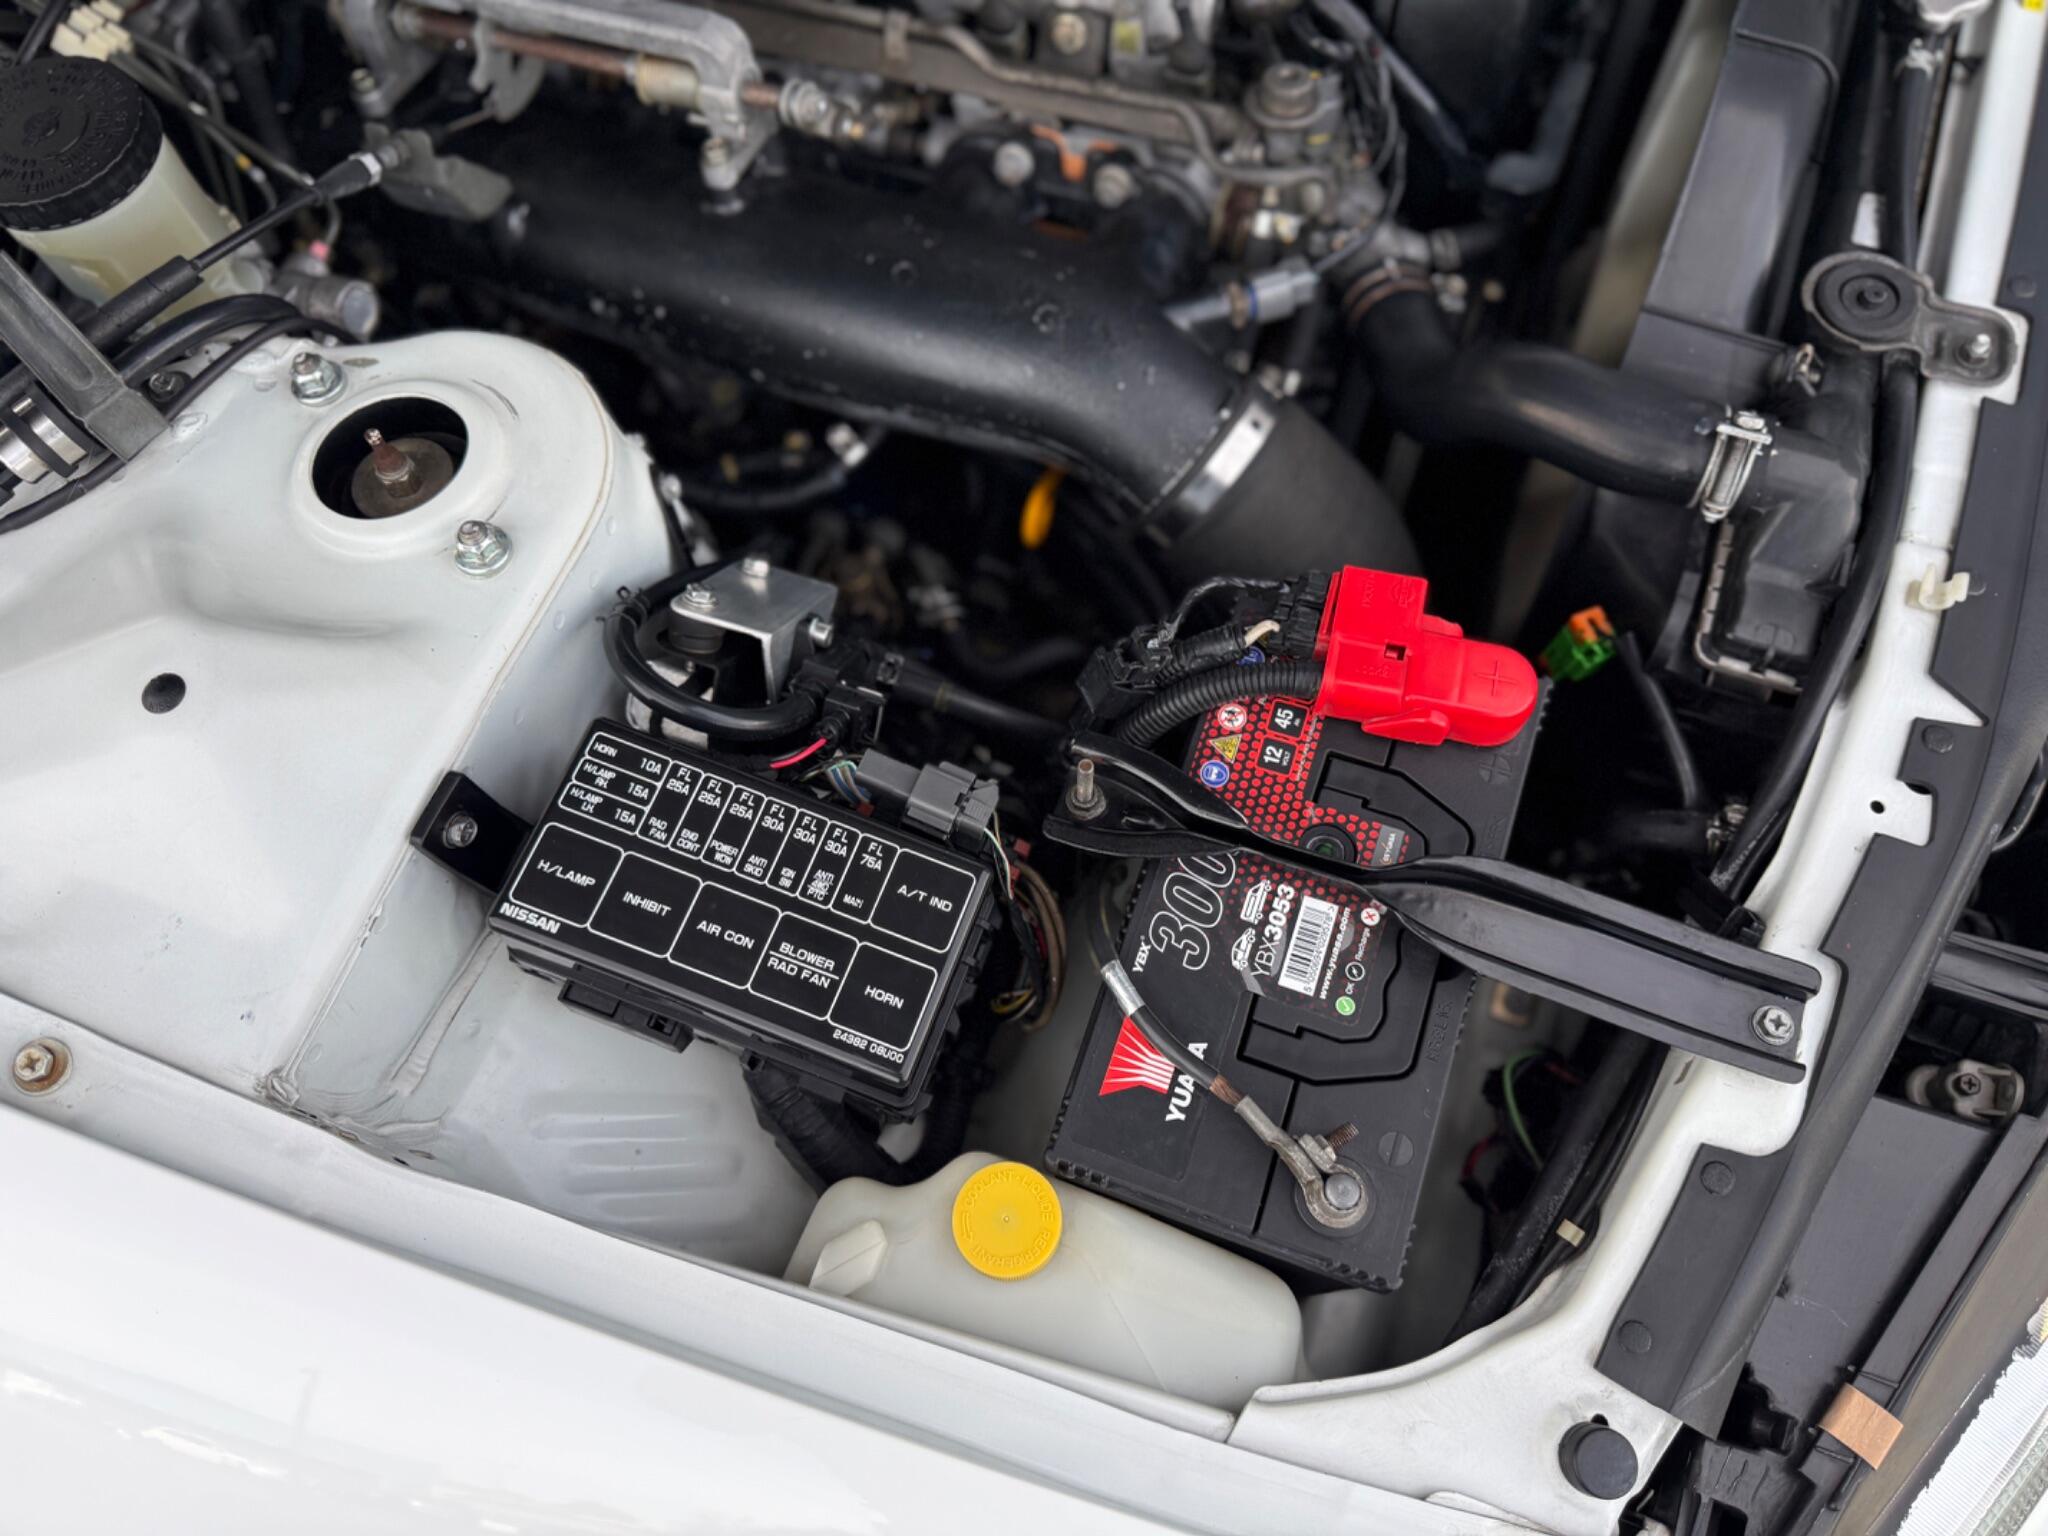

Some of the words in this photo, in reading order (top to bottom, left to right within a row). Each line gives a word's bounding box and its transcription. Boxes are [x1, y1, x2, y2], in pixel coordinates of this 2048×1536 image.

[1274, 708, 1294, 729] 45
[594, 741, 618, 758] HORN
[640, 757, 663, 777] 10A
[1263, 746, 1284, 764] 12
[583, 762, 616, 781] H/LAMP
[627, 782, 651, 801] 15A
[676, 766, 693, 783] FL
[666, 779, 691, 797] 25A
[707, 779, 724, 795] FL
[569, 787, 604, 805] H/LAMP
[614, 807, 637, 827] 15A
[697, 791, 722, 809] 25A
[739, 791, 756, 807] FL
[729, 803, 754, 821] 25A
[770, 802, 786, 819] FL
[648, 816, 668, 831] RAD
[761, 815, 786, 834] 30A
[801, 814, 818, 830] FL
[649, 827, 669, 842] FAN
[792, 826, 817, 846] 30A
[832, 826, 849, 843] FL
[676, 837, 701, 853] CONT
[711, 839, 740, 857] POWER
[824, 839, 848, 858] 30A
[867, 841, 884, 857] FL
[743, 863, 763, 878] SKID
[747, 855, 768, 868] ANTI
[860, 855, 883, 872] 75A
[536, 859, 596, 888] H/LAMP
[622, 891, 673, 917] INHIBIT
[843, 894, 864, 909] MAIN
[896, 885, 928, 903] A/T
[928, 896, 953, 913] IND
[499, 902, 562, 935] NISSAN
[696, 919, 722, 936] AIR
[723, 929, 756, 951] CON
[1251, 883, 1295, 977] YBX3053
[779, 941, 836, 972] BLOWER
[1319, 907, 1351, 1000] www.yuasa.com
[767, 956, 798, 976] RAD
[800, 969, 832, 989] FAN
[864, 985, 905, 1010] HORN
[1345, 982, 1356, 995] OK
[832, 1029, 869, 1050] 24382
[1165, 1042, 1209, 1123] YUAA
[965, 1168, 1014, 1207] COOLANT
